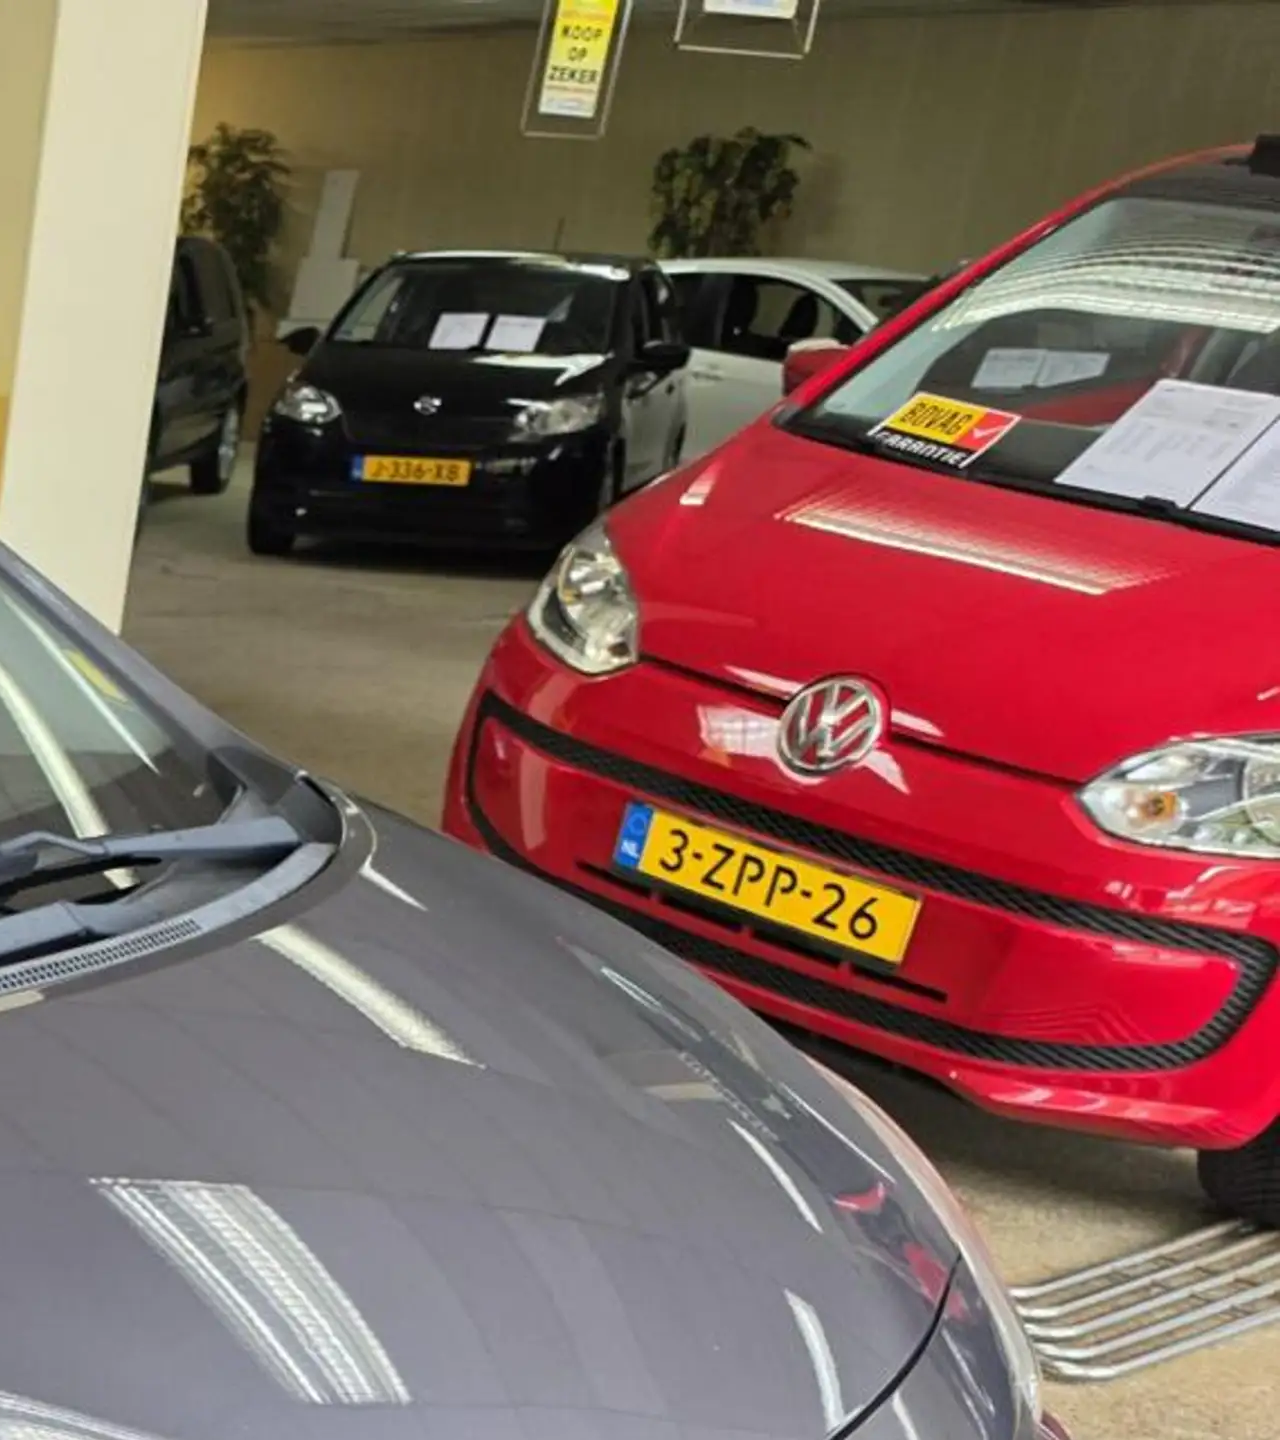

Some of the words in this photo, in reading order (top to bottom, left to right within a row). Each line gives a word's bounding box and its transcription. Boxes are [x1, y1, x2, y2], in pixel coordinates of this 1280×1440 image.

[548, 65, 598, 83] ZEKER
[899, 401, 973, 436] BOVAG
[659, 829, 879, 941] 3-ZPP-26
